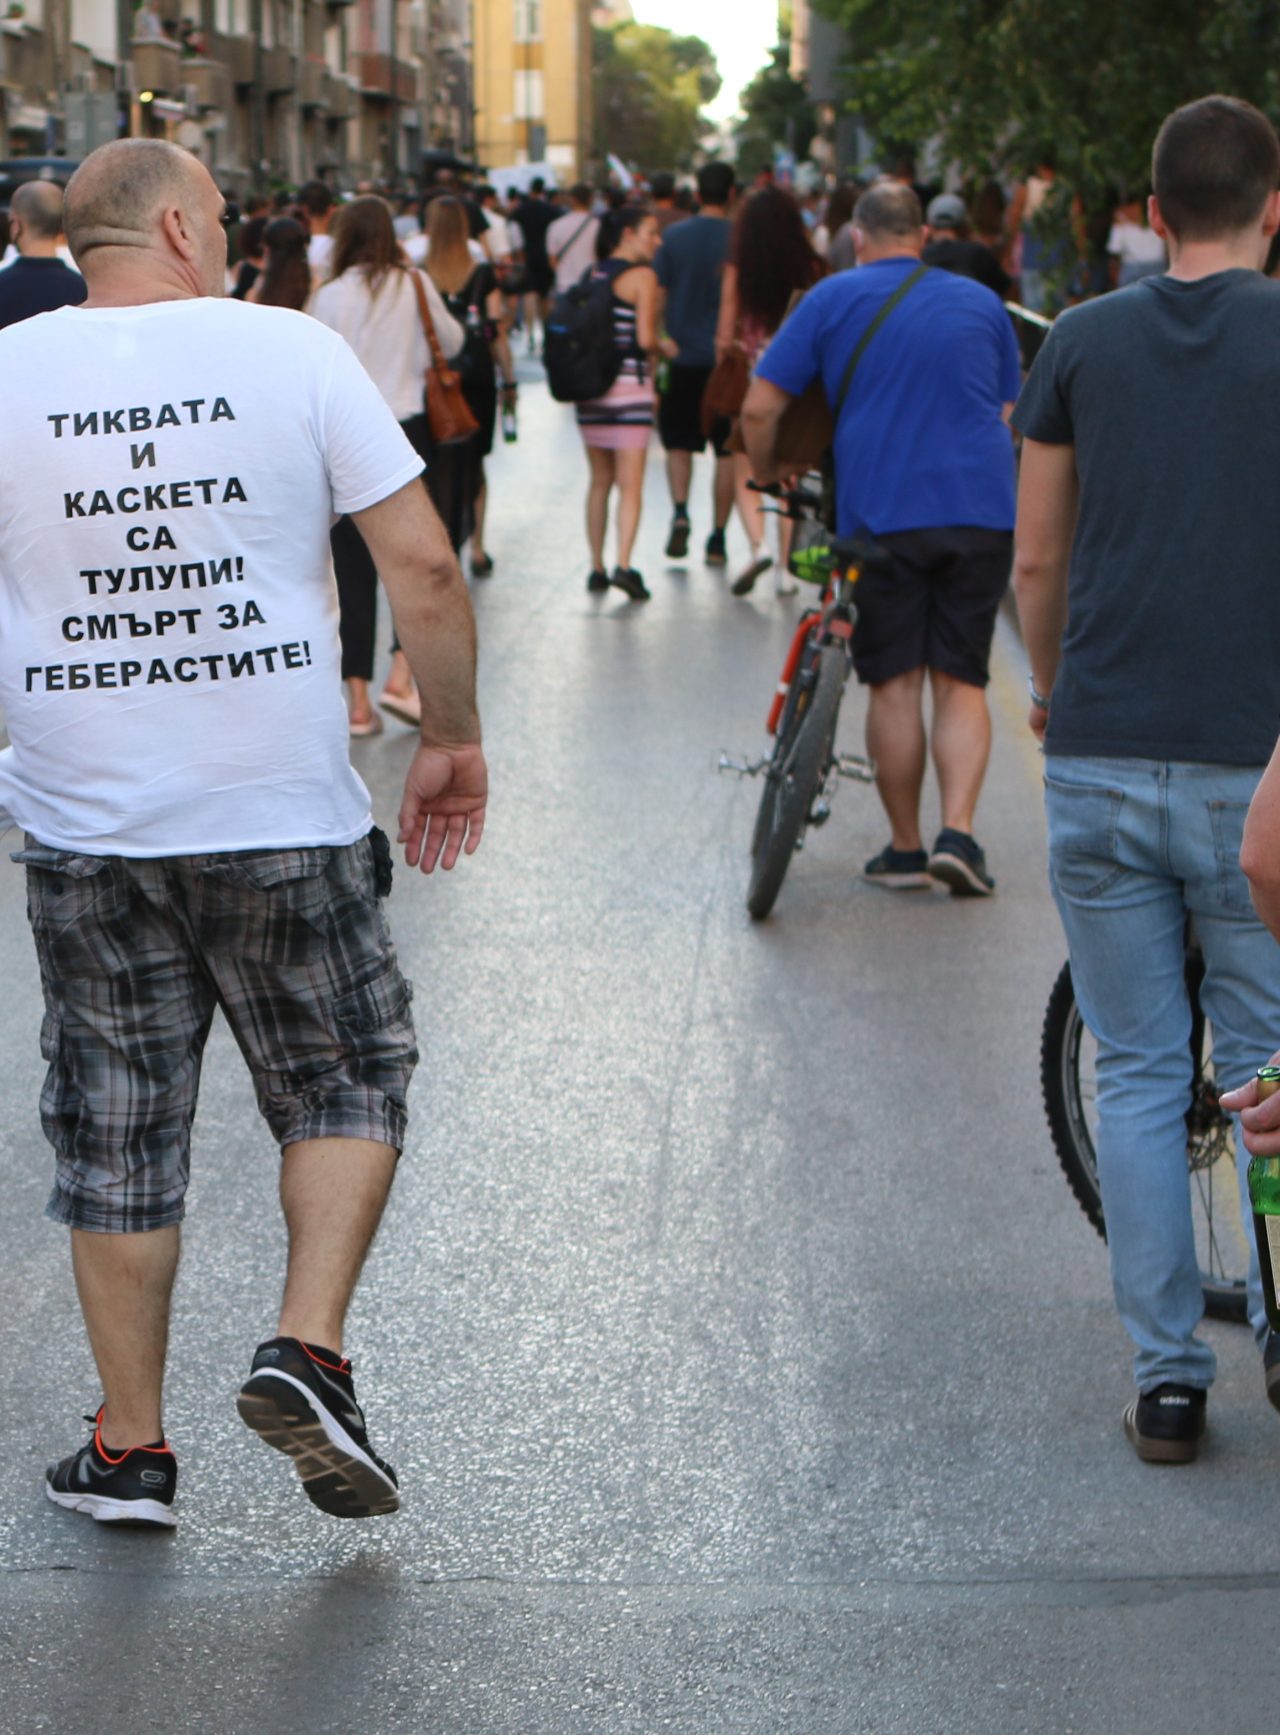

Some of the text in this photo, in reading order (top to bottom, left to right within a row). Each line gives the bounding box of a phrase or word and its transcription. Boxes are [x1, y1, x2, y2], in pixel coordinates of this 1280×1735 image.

[47, 397, 236, 438] ТИКВАТА
[130, 442, 156, 470] И
[63, 476, 248, 519] КАСКЕТА
[126, 525, 177, 552] СА
[79, 556, 244, 595] ТУЛУПИ!
[61, 600, 266, 642] СМЪРТ ЗА
[25, 640, 312, 693] ГЕБЕРАСТИТЕ!
